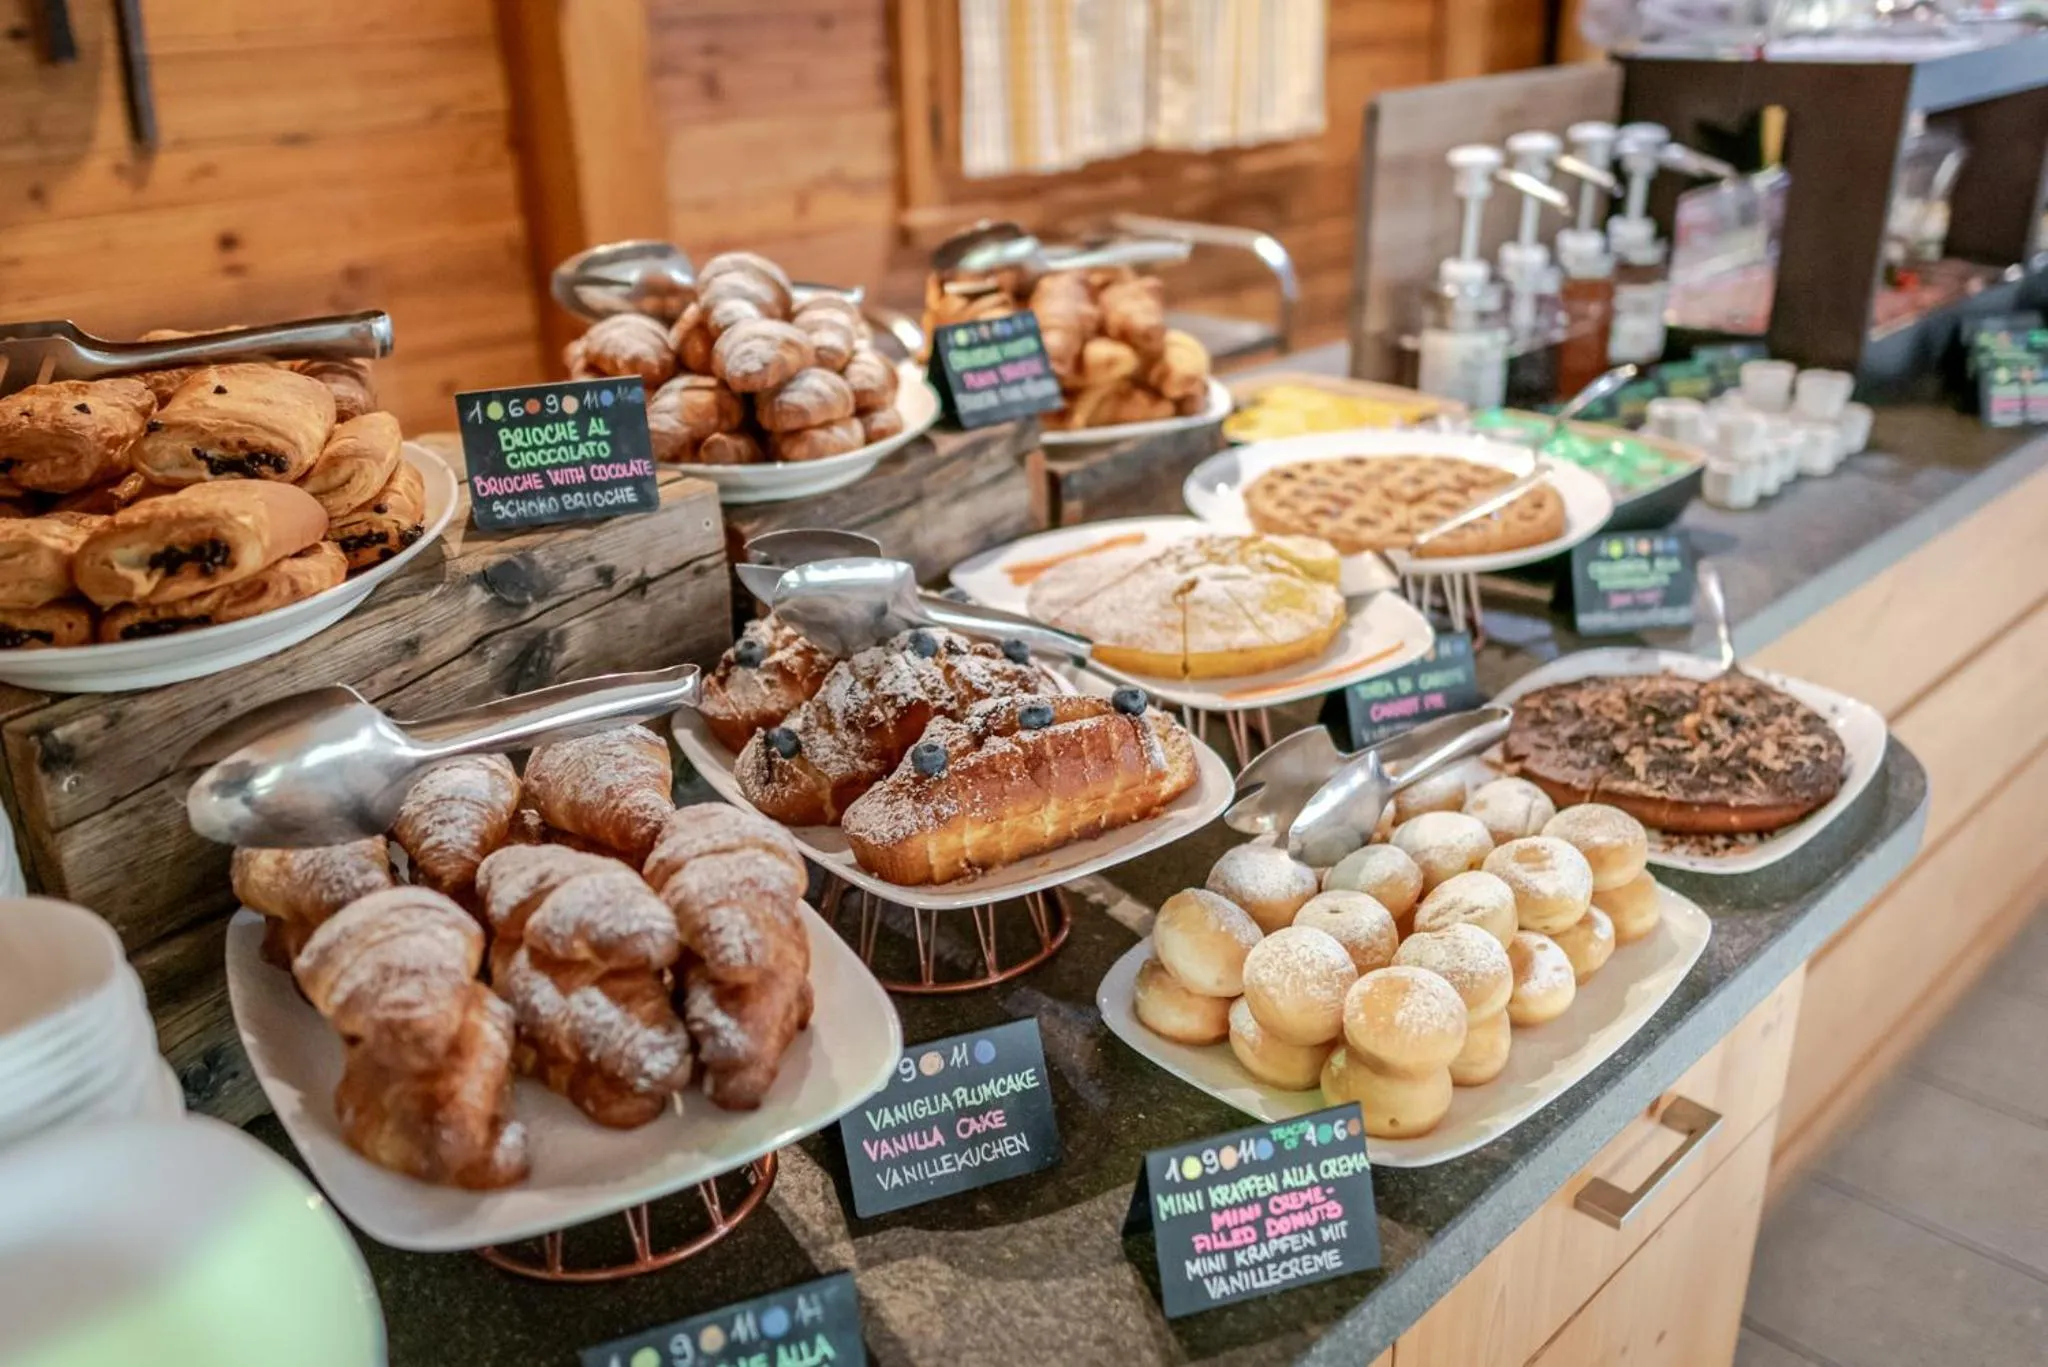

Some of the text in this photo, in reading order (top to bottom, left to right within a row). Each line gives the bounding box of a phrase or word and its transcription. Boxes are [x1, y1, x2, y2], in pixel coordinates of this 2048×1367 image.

[508, 398, 525, 418] 6
[545, 394, 560, 413] 9
[498, 417, 612, 452] BRIOCHE AL
[506, 441, 611, 469] CIOCCOLATO
[473, 473, 544, 497] BRIOCHE
[546, 464, 587, 487] WITH
[492, 487, 639, 519] SCHOKO BRIOCHE
[898, 1057, 917, 1082] 9
[865, 1068, 1040, 1132] VANIGLIA PLUMCAKE
[862, 1109, 1007, 1163] VANILLA CAKE
[1333, 1119, 1347, 1141] 6
[876, 1132, 1030, 1192] VANILLEKUCHEN
[1165, 1157, 1181, 1183] 1
[1202, 1148, 1220, 1174] 9
[1156, 1151, 1371, 1222] MINI KRAPFEN ALLA CREMA
[1191, 1201, 1344, 1254] FILLED DONUTS
[1210, 1203, 1262, 1233] MINI
[1184, 1219, 1349, 1281] MINI KRAPFEN MIT
[1203, 1248, 1344, 1299] VANILLECREME
[669, 1333, 695, 1367] 9
